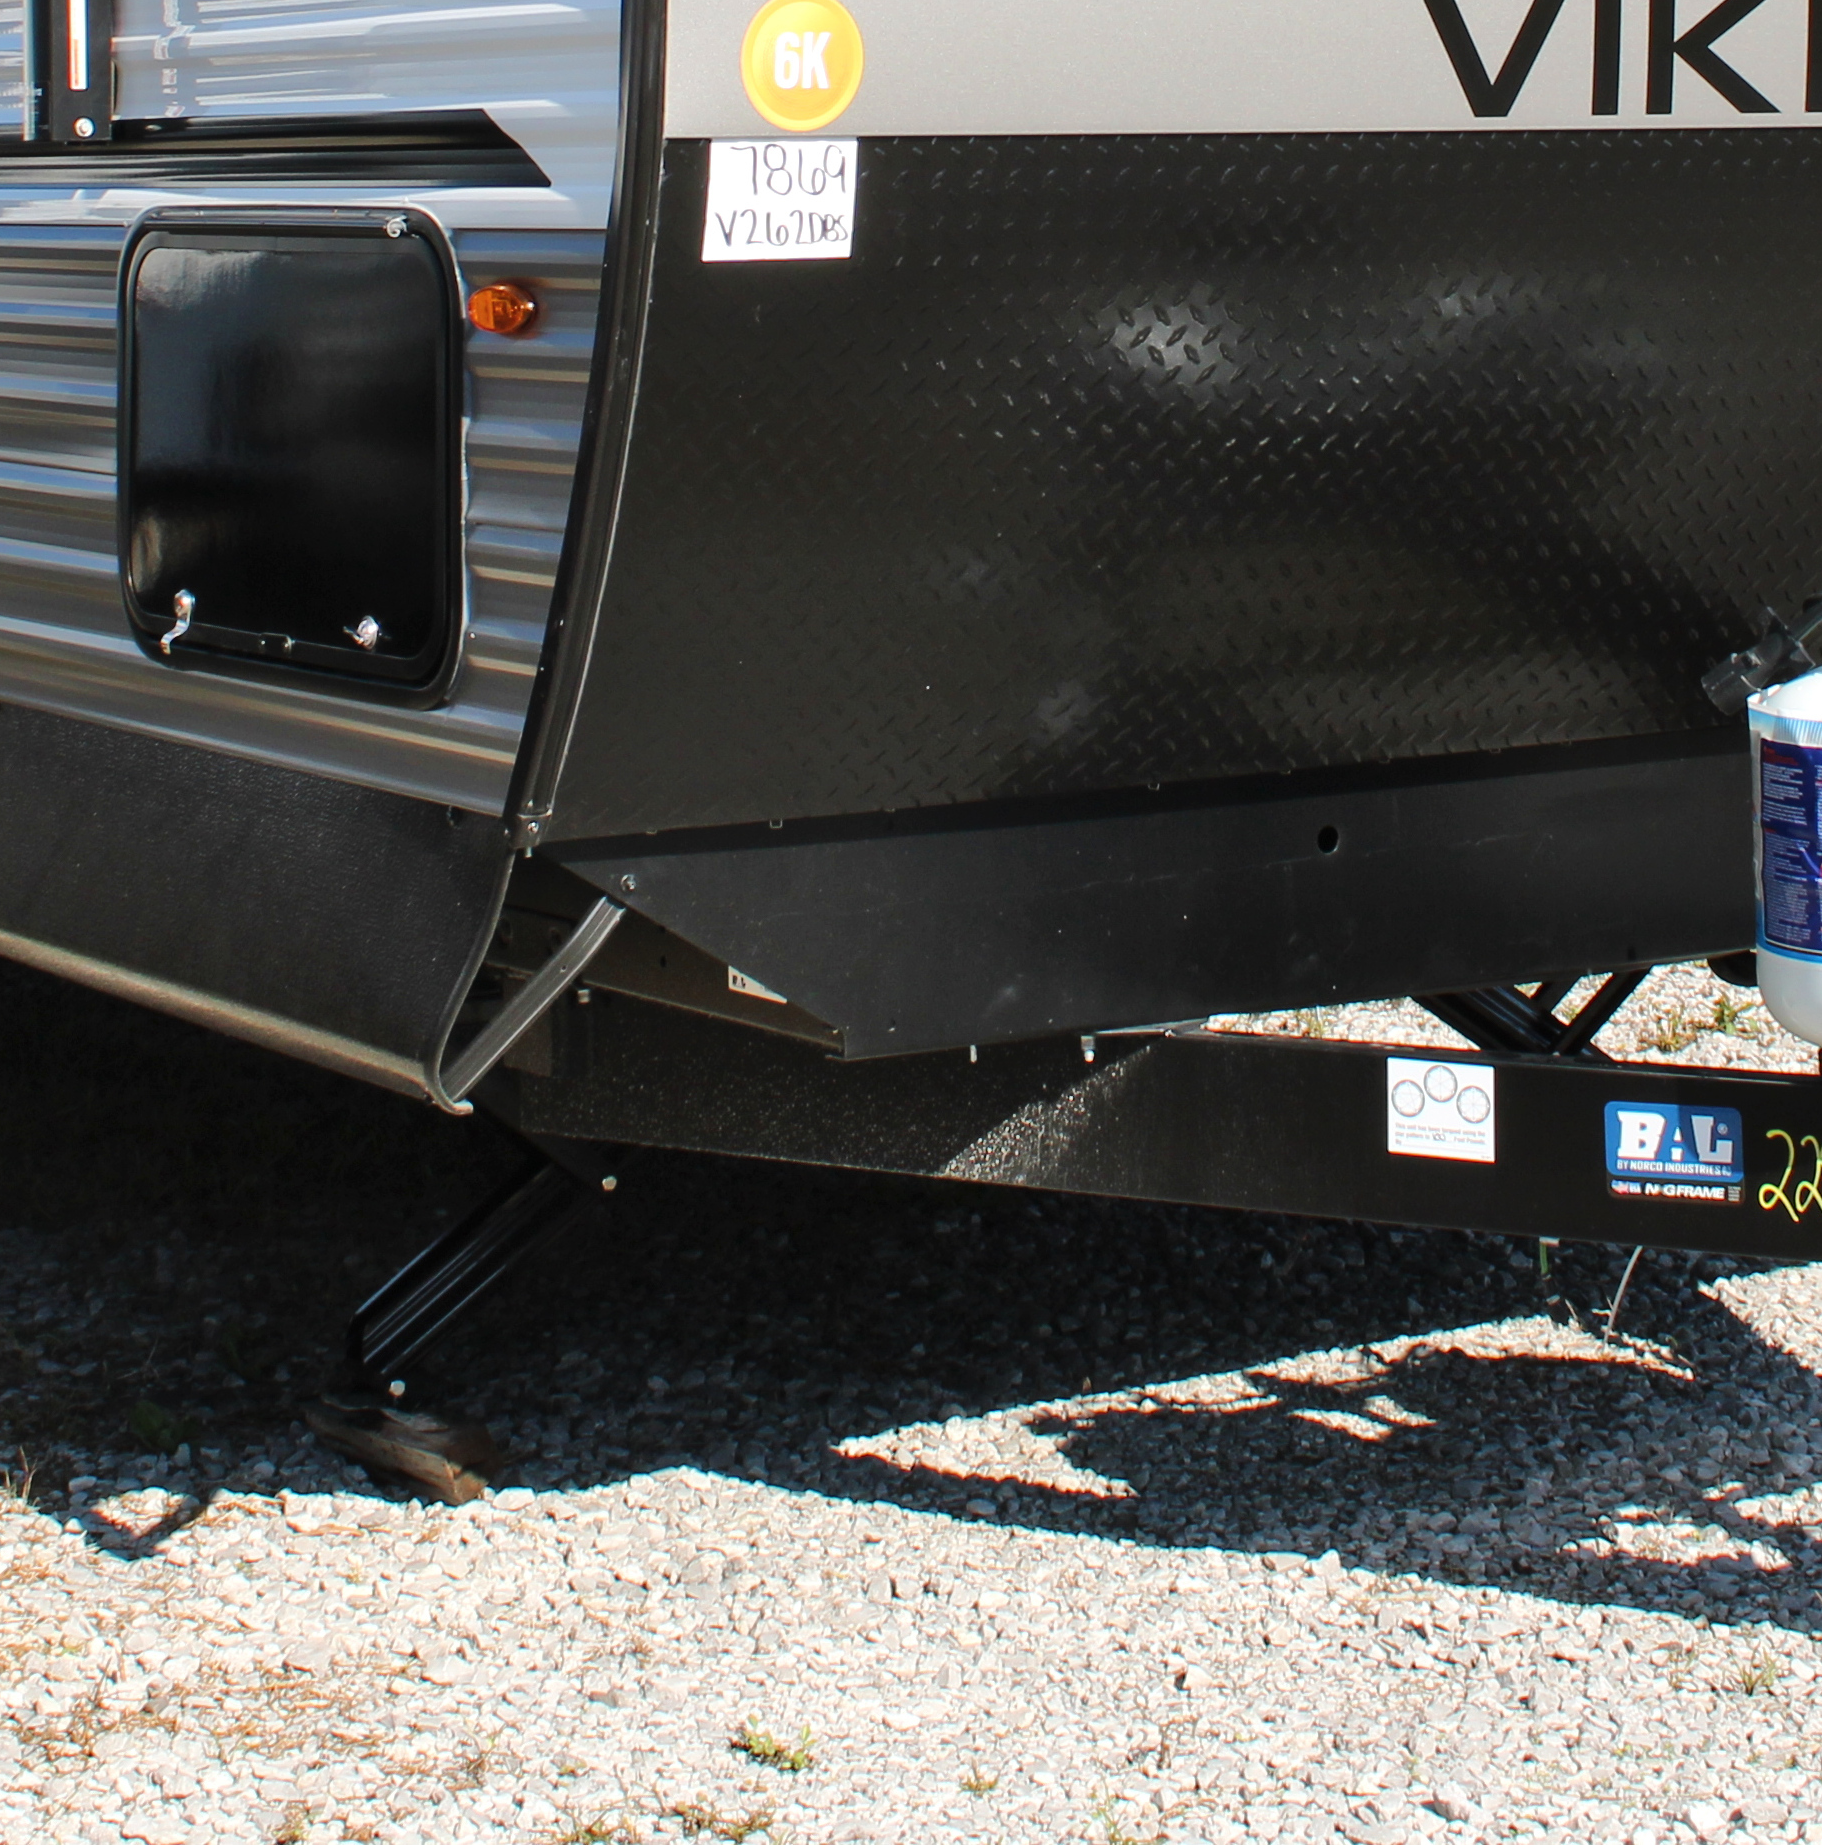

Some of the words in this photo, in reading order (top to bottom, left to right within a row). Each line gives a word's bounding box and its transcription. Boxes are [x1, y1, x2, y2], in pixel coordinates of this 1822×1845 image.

[773, 30, 833, 90] 6K
[1629, 1160, 1664, 1173] NORCO
[1664, 1161, 1723, 1176] INDUSTRIES
